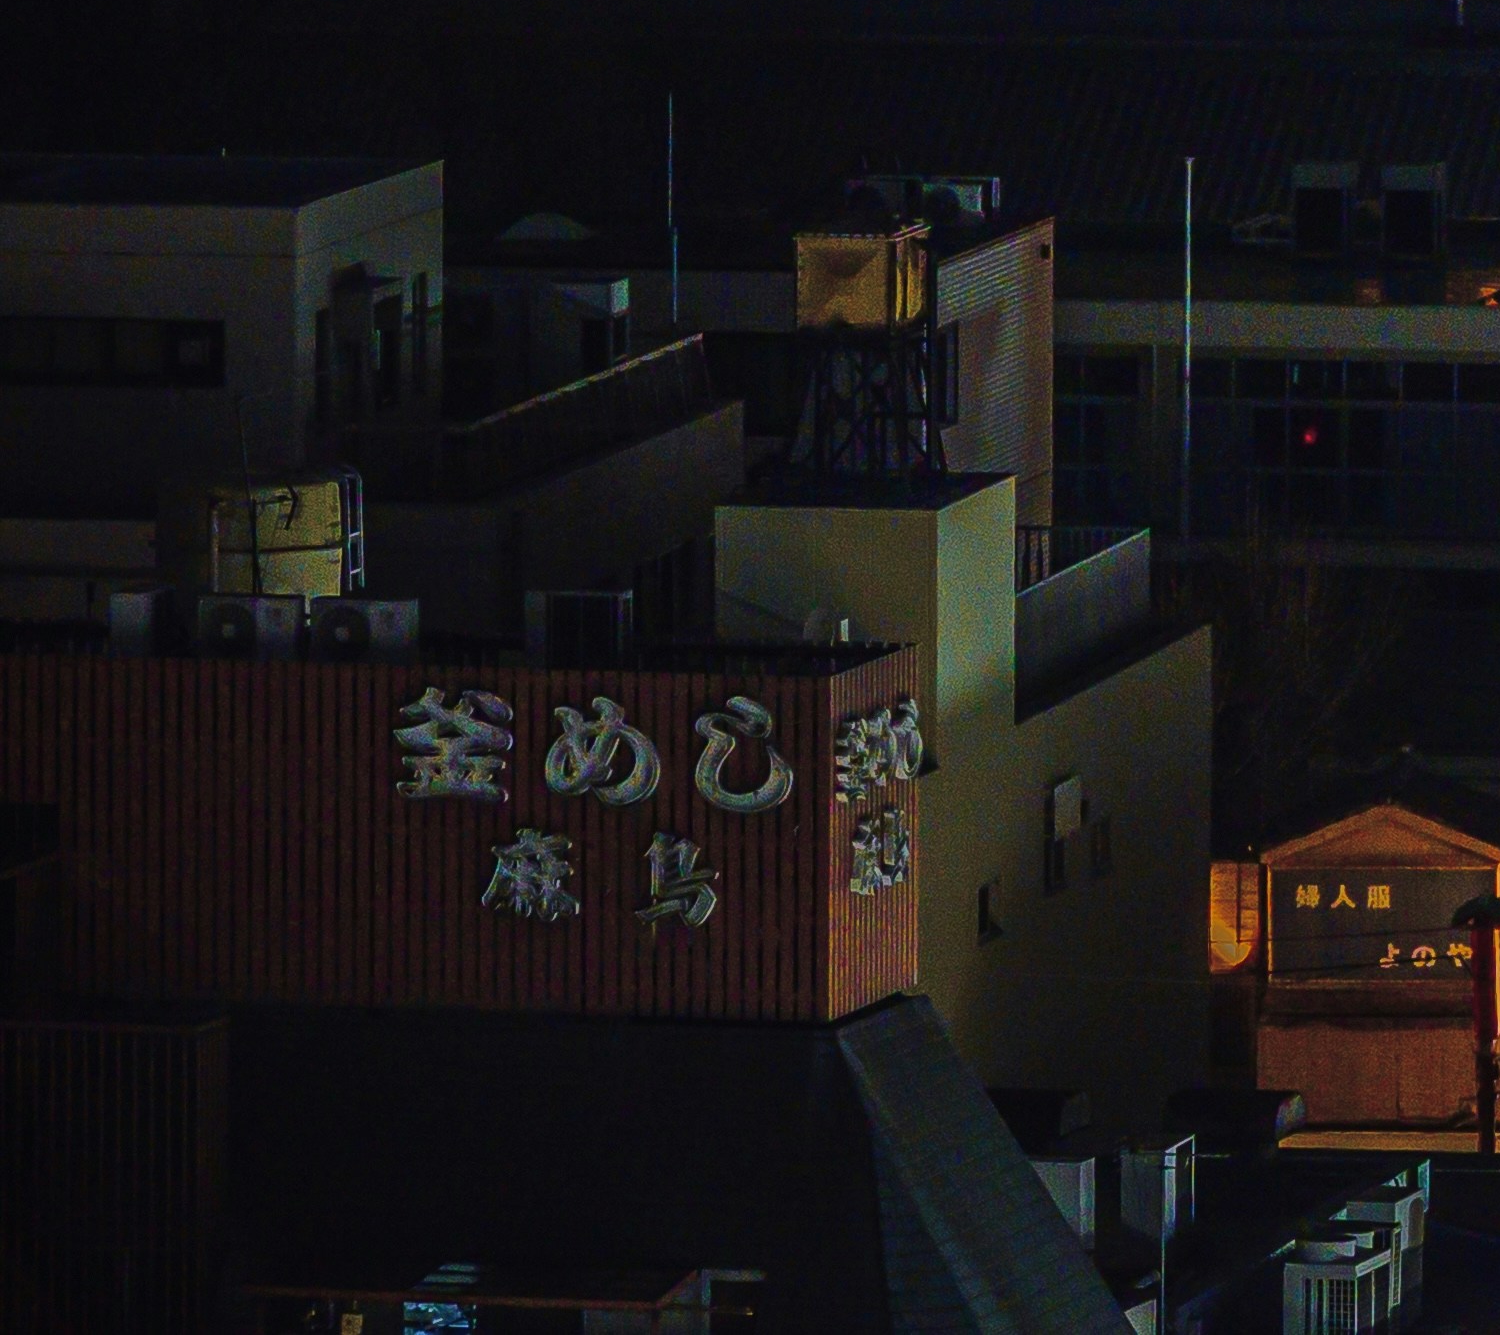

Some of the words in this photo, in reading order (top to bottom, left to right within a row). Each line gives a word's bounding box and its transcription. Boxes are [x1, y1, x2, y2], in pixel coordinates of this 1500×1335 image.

[394, 687, 793, 812] 釜めし
[1295, 884, 1391, 909] 婦人服
[1379, 943, 1473, 968] よのや
